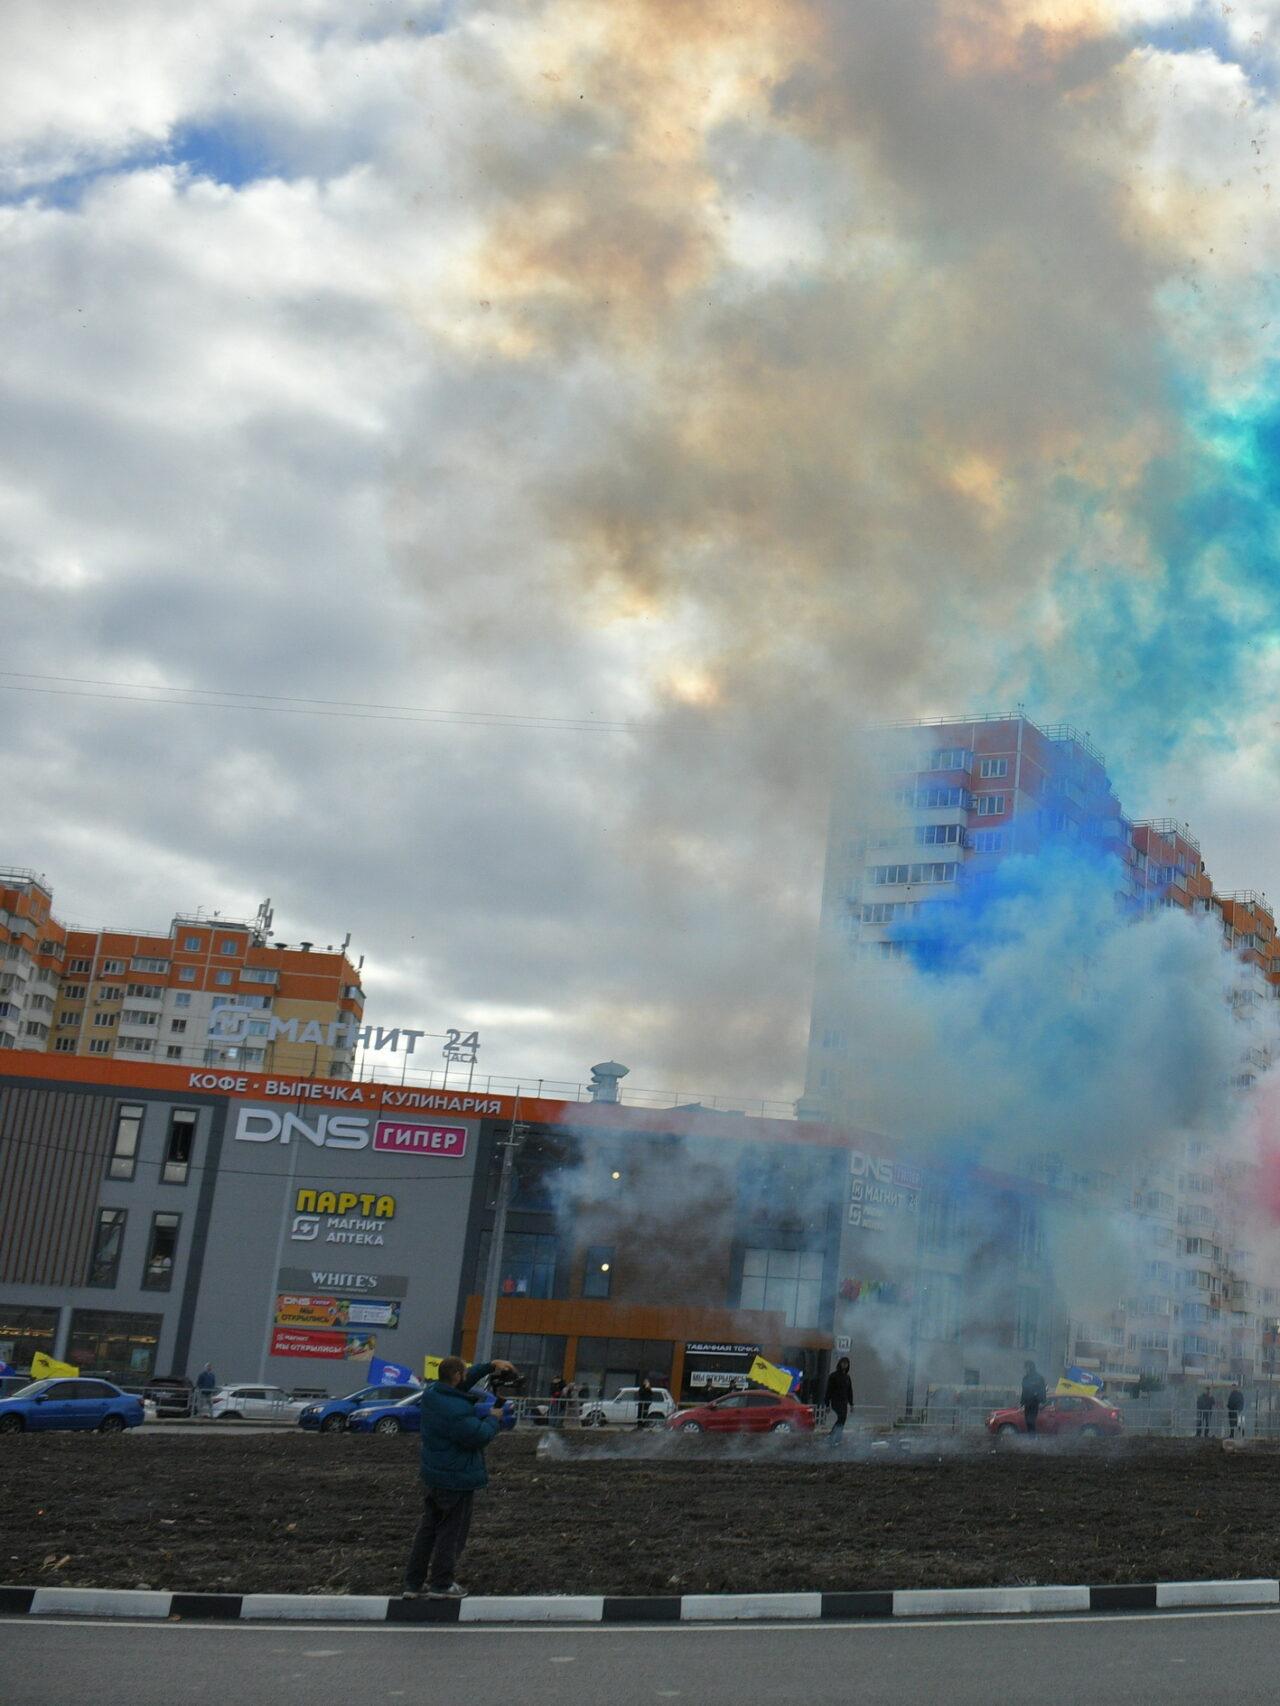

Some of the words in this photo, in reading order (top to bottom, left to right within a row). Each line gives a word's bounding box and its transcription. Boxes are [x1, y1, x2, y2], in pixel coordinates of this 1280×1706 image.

[267, 1016, 424, 1054] МАГНИТ
[443, 1029, 480, 1052] 24
[442, 1051, 478, 1064] ЧАСА
[188, 1072, 247, 1092] КОФЕ
[265, 1080, 364, 1102] ВЫПЕЧКА
[382, 1091, 502, 1115] КУЛИНАРИЯ
[235, 1107, 370, 1150] DNS
[382, 1128, 458, 1149] ГИПЕР
[296, 1189, 396, 1218] ПАРТА
[326, 1217, 385, 1232] МАГНИТ
[326, 1232, 384, 1246] АПТЕКА
